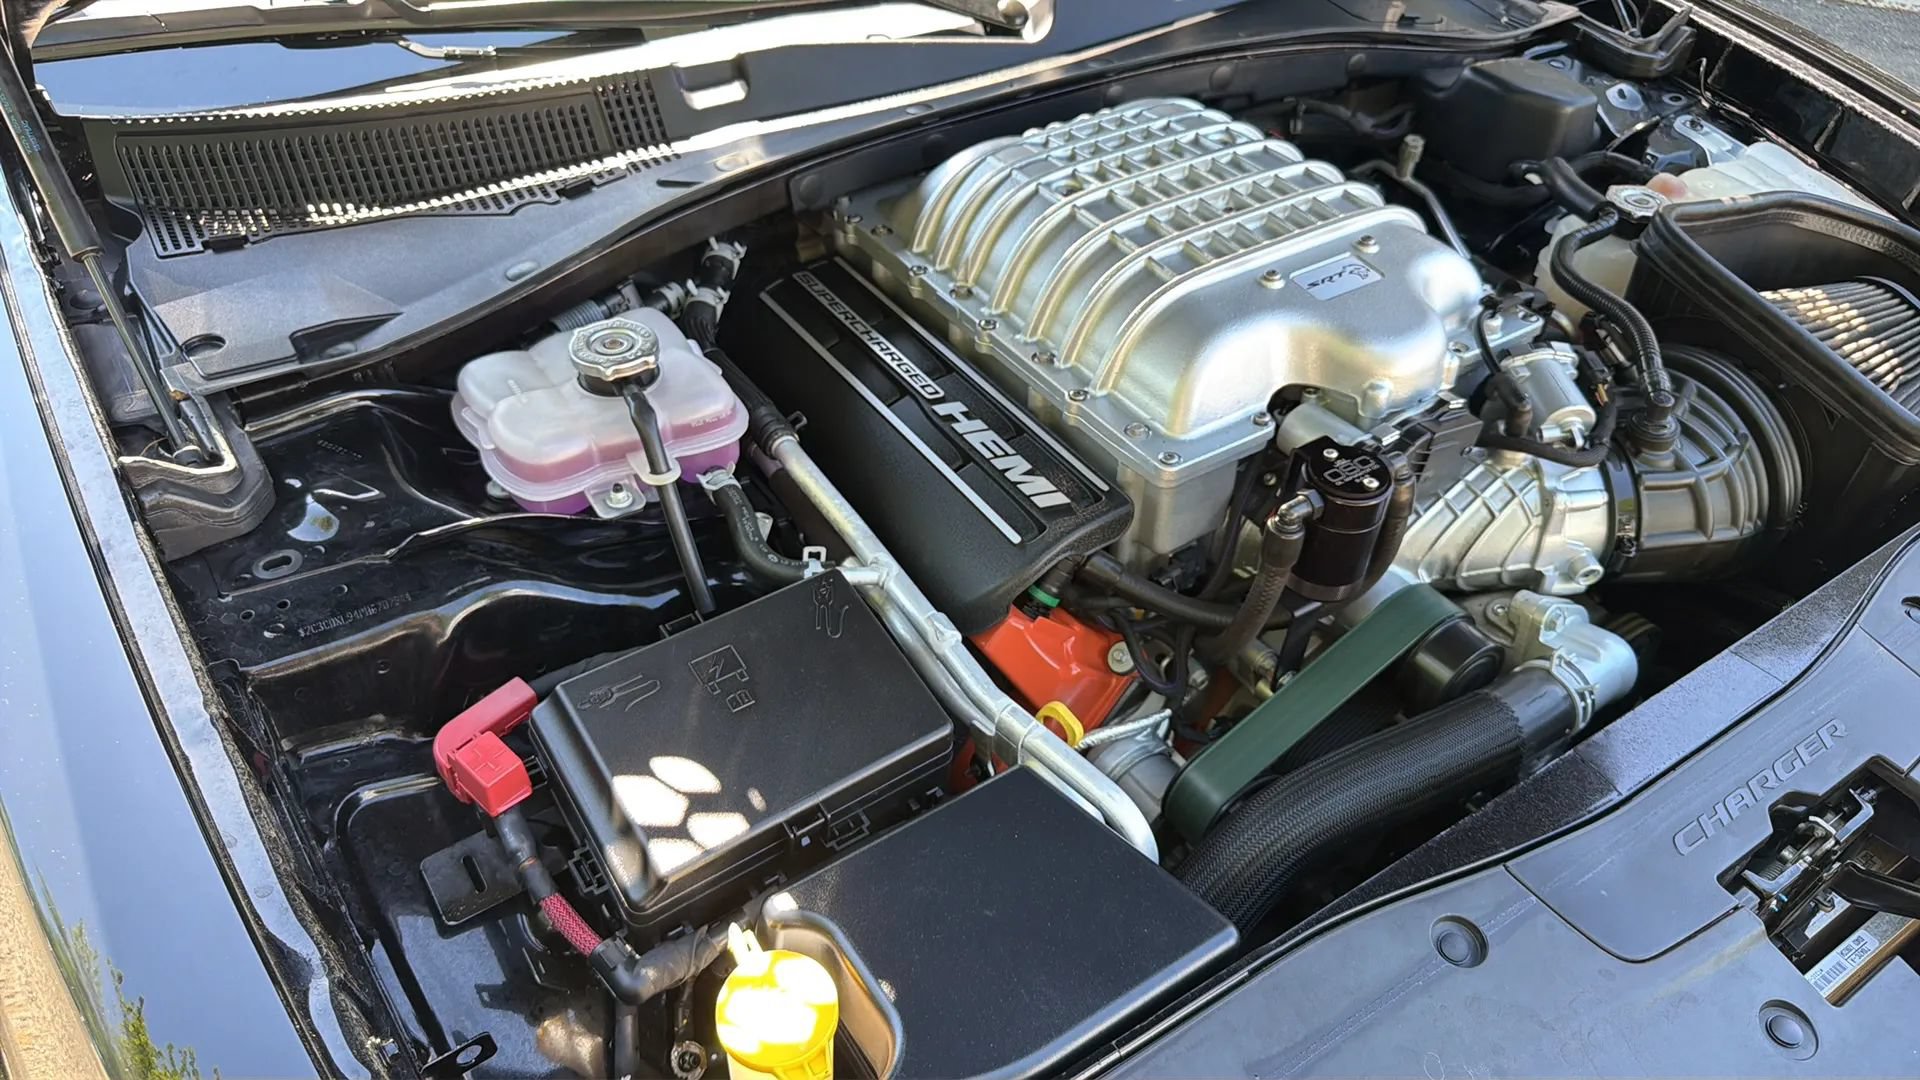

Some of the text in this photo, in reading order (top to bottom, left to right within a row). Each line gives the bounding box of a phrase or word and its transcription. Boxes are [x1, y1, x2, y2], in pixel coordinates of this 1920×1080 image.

[1306, 269, 1346, 290] SRT
[796, 272, 1072, 508] SUPERCHARGED HEMI
[1672, 718, 1848, 857] CHARGER
